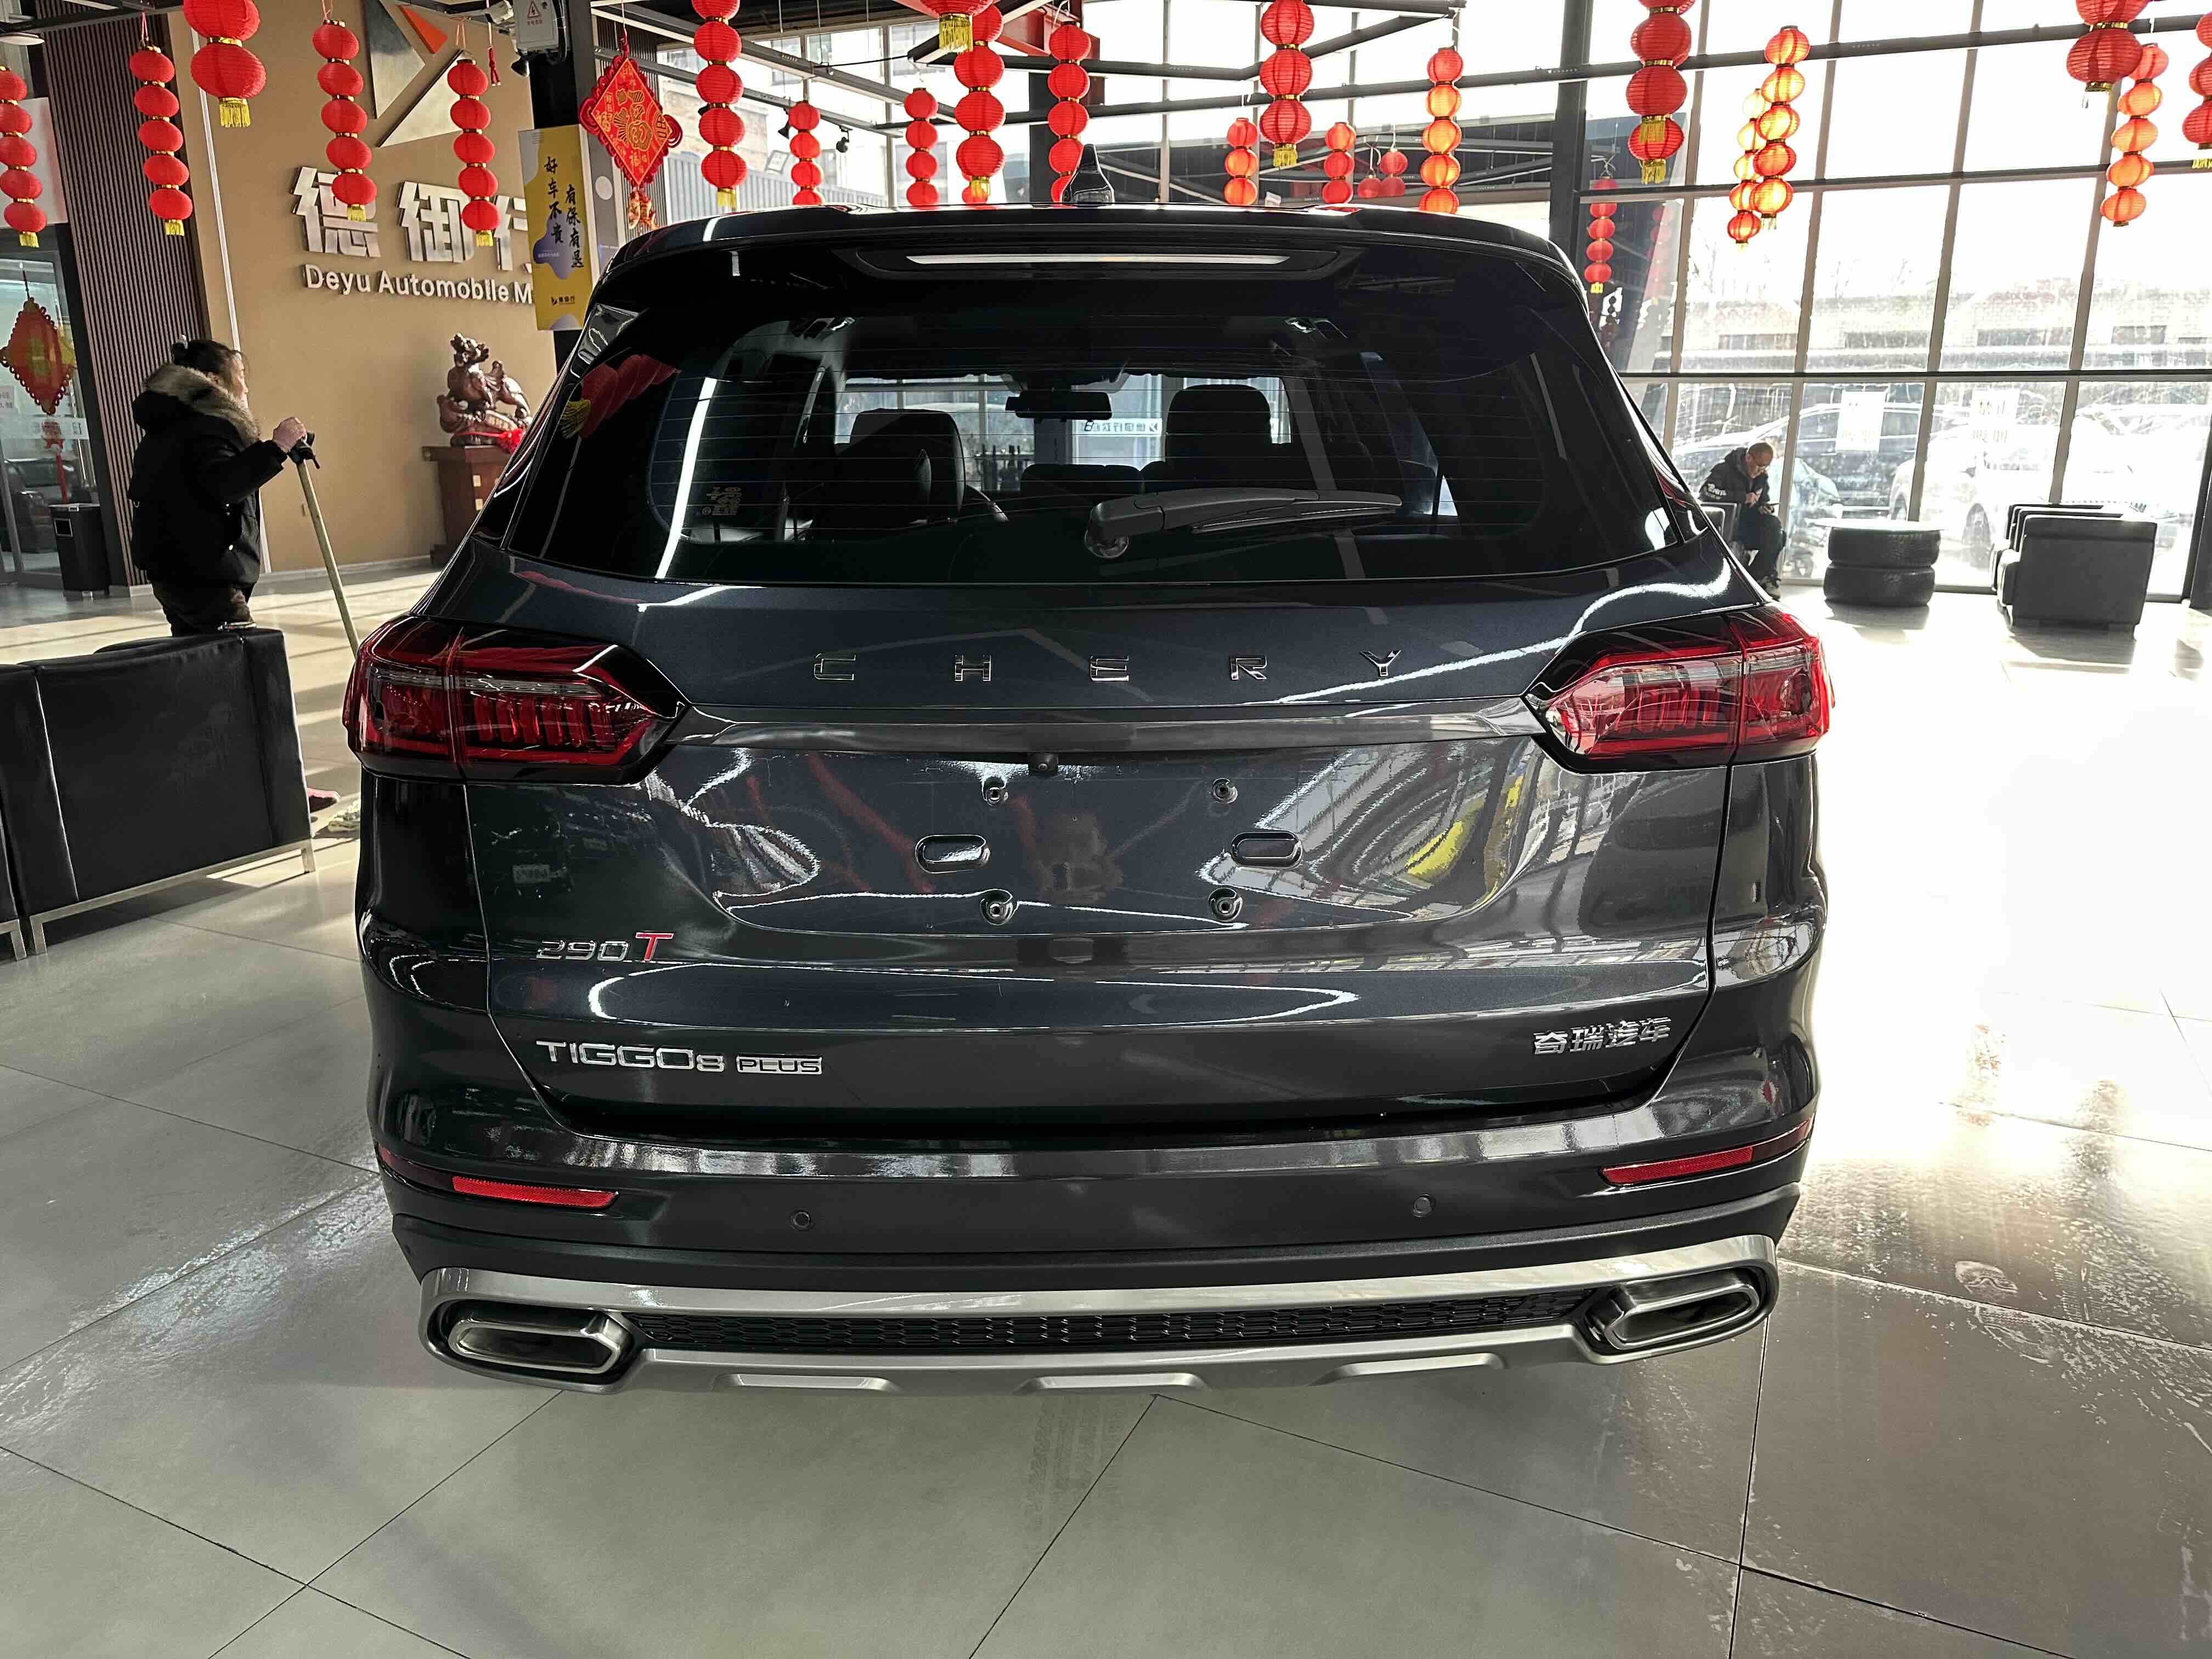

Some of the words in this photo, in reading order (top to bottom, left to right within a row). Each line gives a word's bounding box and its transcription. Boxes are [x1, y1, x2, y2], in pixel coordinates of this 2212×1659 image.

[544, 156, 564, 244] 好车不贵
[304, 264, 371, 295] Deyu
[379, 270, 509, 303] Automobile
[814, 650, 1402, 681] CHERY
[535, 932, 674, 961] 290T
[1533, 1017, 1672, 1054] 奇瑞汽车
[736, 1056, 822, 1074] PLUS
